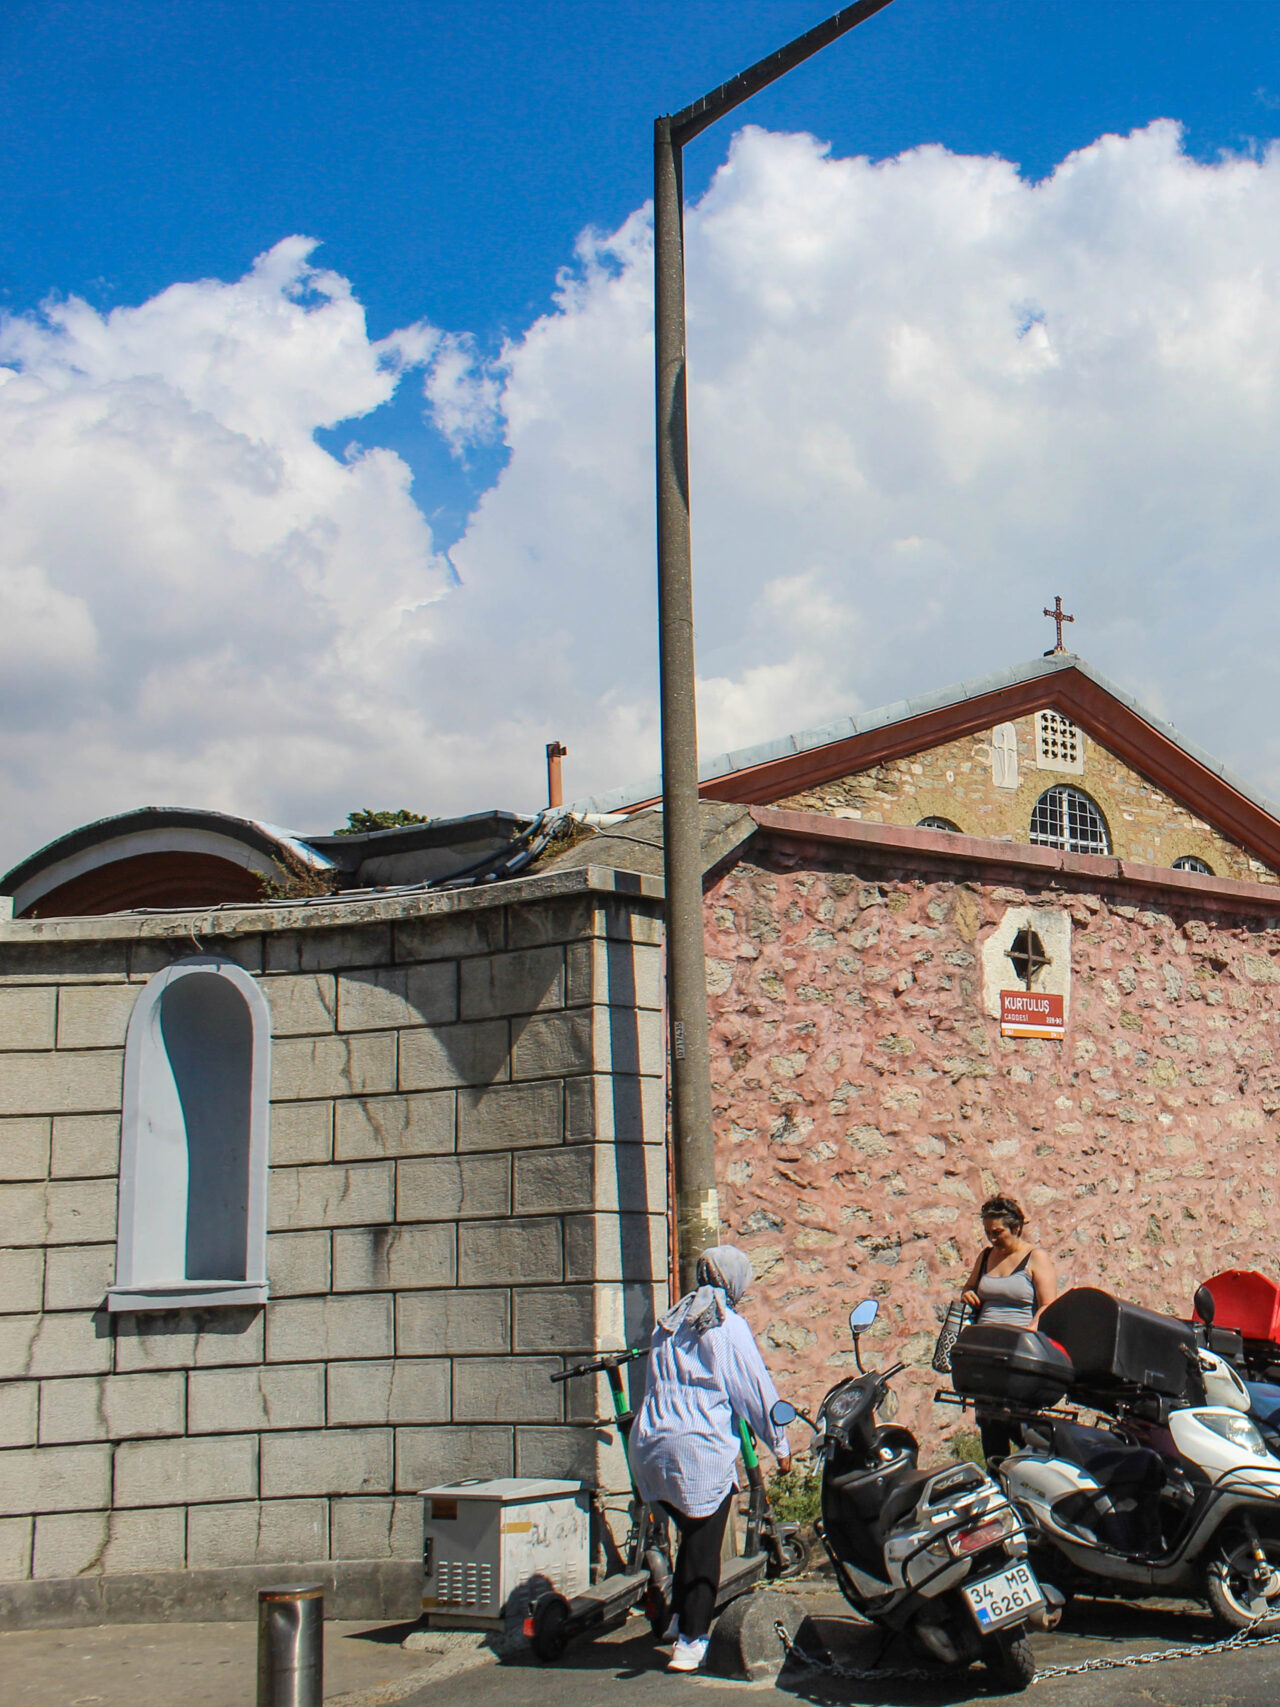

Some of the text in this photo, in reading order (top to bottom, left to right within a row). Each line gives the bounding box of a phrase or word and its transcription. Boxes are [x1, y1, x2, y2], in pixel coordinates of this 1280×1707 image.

[1004, 996, 1050, 1015] KURTULUŞ
[1004, 1013, 1029, 1022] CADDESİ
[970, 1568, 1030, 1604] 34 MB
[990, 1587, 1032, 1617] 6261
